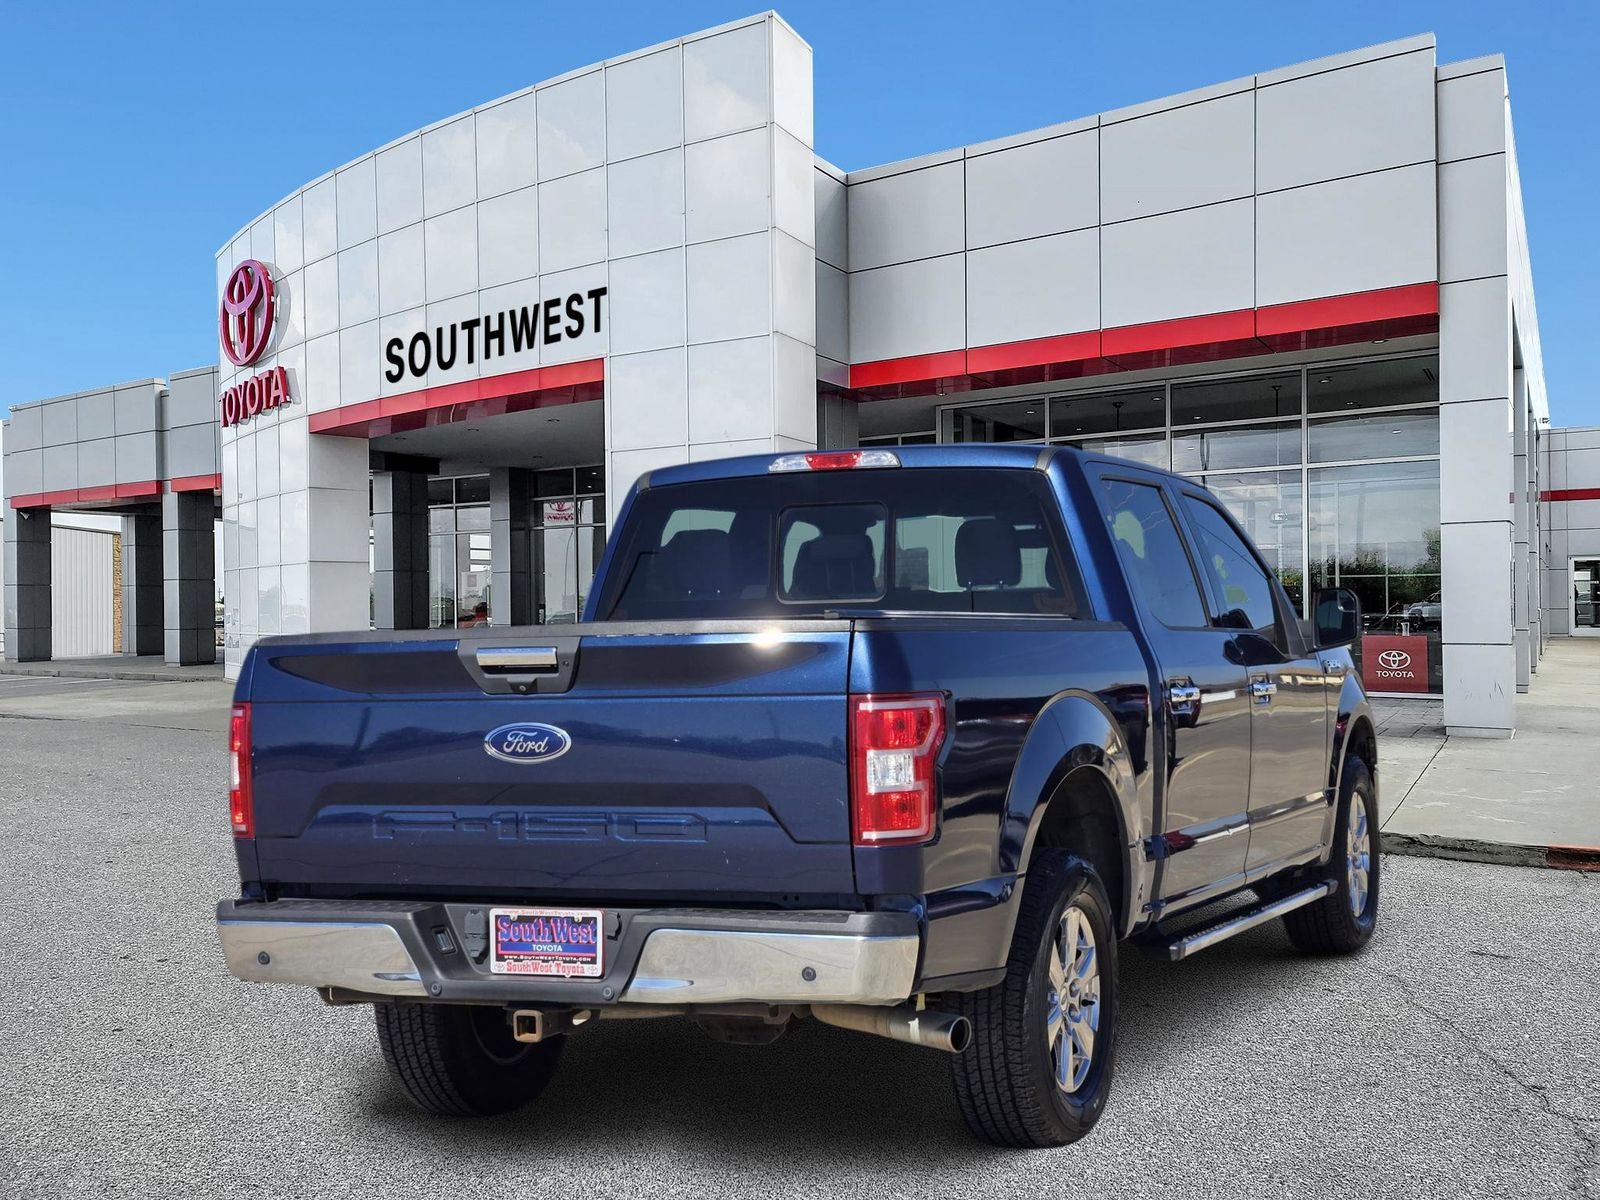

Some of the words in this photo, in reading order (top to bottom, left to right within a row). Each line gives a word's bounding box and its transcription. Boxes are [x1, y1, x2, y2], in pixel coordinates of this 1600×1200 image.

[385, 287, 608, 383] SOUTHWEST
[219, 366, 292, 428] TOYOTA
[1376, 670, 1414, 678] TOYOTA
[503, 730, 548, 753] Ford
[372, 811, 708, 843] F-150
[498, 916, 597, 943] SouthWest
[532, 944, 563, 952] TOYOTA
[506, 962, 553, 973] SouthWest
[555, 963, 585, 975] Toyota
